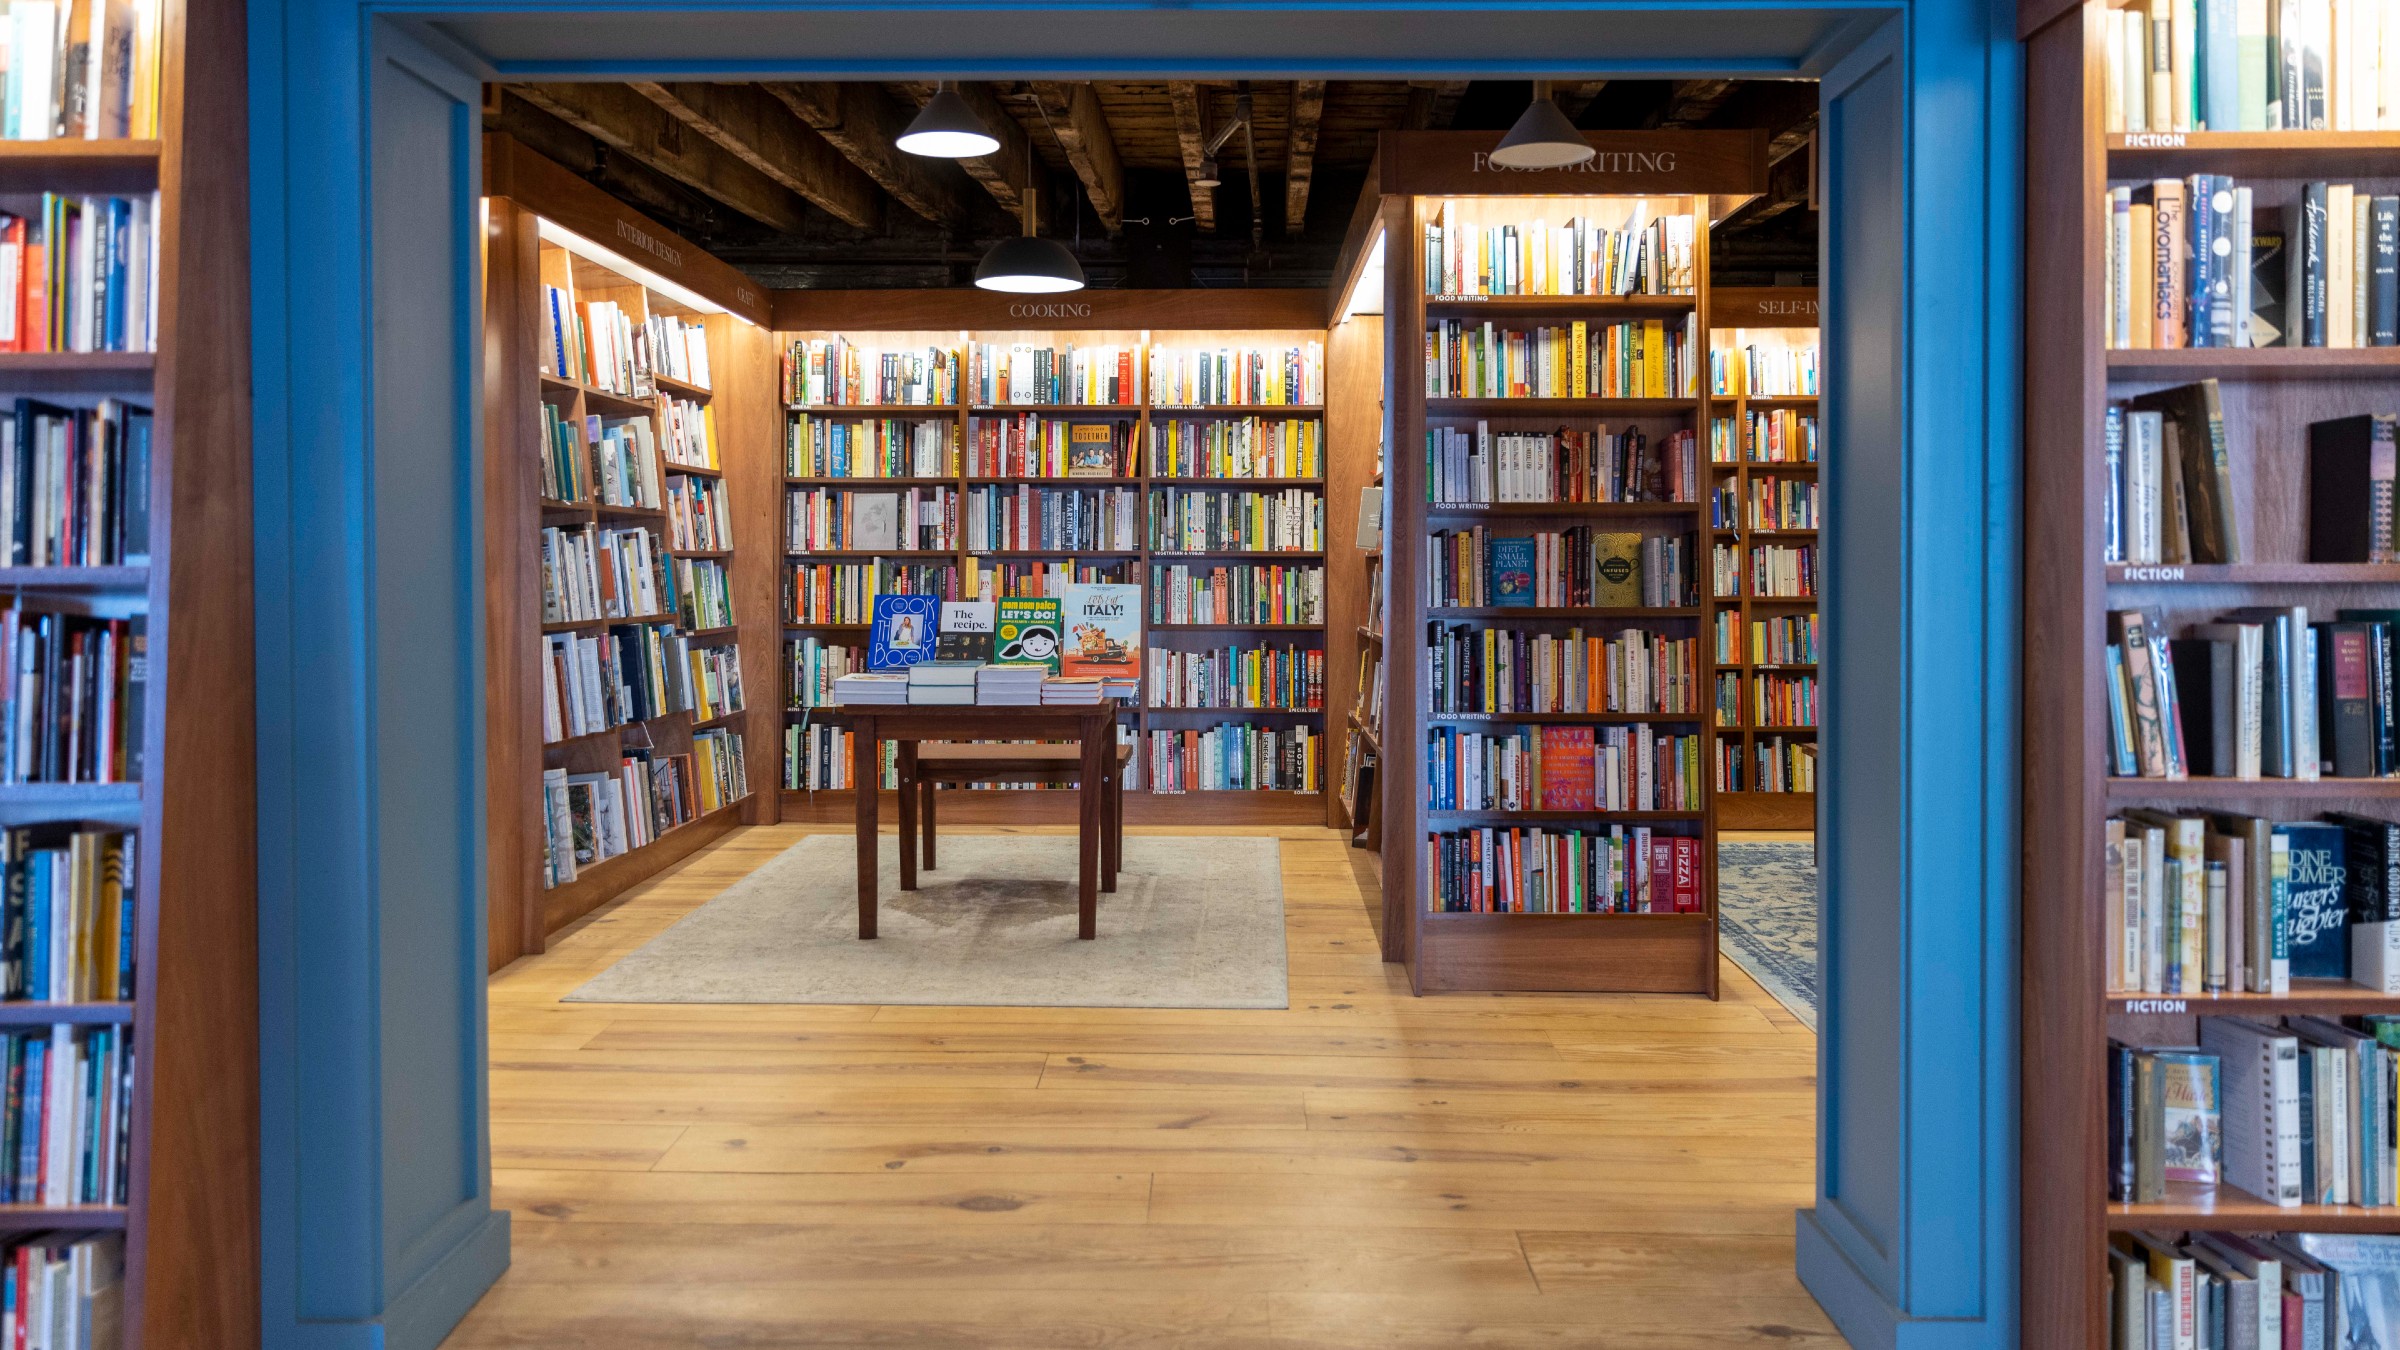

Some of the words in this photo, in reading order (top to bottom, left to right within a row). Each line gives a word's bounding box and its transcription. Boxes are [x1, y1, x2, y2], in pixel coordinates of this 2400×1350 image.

[2125, 134, 2186, 147] FICTION
[2171, 203, 2181, 221] The
[2377, 211, 2394, 221] Life
[617, 219, 655, 253] INTERIOR
[656, 238, 682, 267] DESIGN
[2379, 233, 2393, 242] the
[2377, 244, 2394, 255] Top
[2157, 197, 2179, 320] Lovomaniacs
[737, 286, 754, 308] CRAFT
[1010, 303, 1091, 318] COOKING
[1075, 432, 1108, 440] TOGETHER
[1497, 552, 1527, 560] SMALL
[1498, 545, 1520, 553] DIET
[1495, 560, 1529, 568] PLANET
[2124, 568, 2184, 580] FICTION
[879, 597, 936, 620] COOK
[954, 609, 973, 619] The
[1002, 601, 1018, 609] nom
[1019, 601, 1035, 610] nom
[1083, 604, 1124, 616] ITALY!
[1001, 610, 1031, 619] LET'S
[1033, 610, 1056, 620] GO!
[953, 620, 988, 631] recipe.
[874, 642, 931, 665] BOOK
[2383, 637, 2391, 656] The
[1434, 646, 1443, 665] Black
[1434, 667, 1443, 689] Smoke
[2384, 657, 2392, 688] Middle
[2385, 691, 2394, 727] Ground
[2388, 828, 2400, 866] NADINE
[1678, 846, 1689, 885] PIZZA
[2289, 849, 2332, 867] DINE
[2288, 867, 2347, 884] DIMER
[2388, 867, 2400, 917] GORDIMER
[2389, 924, 2400, 949] JUMP
[2126, 1001, 2187, 1014] FICTION
